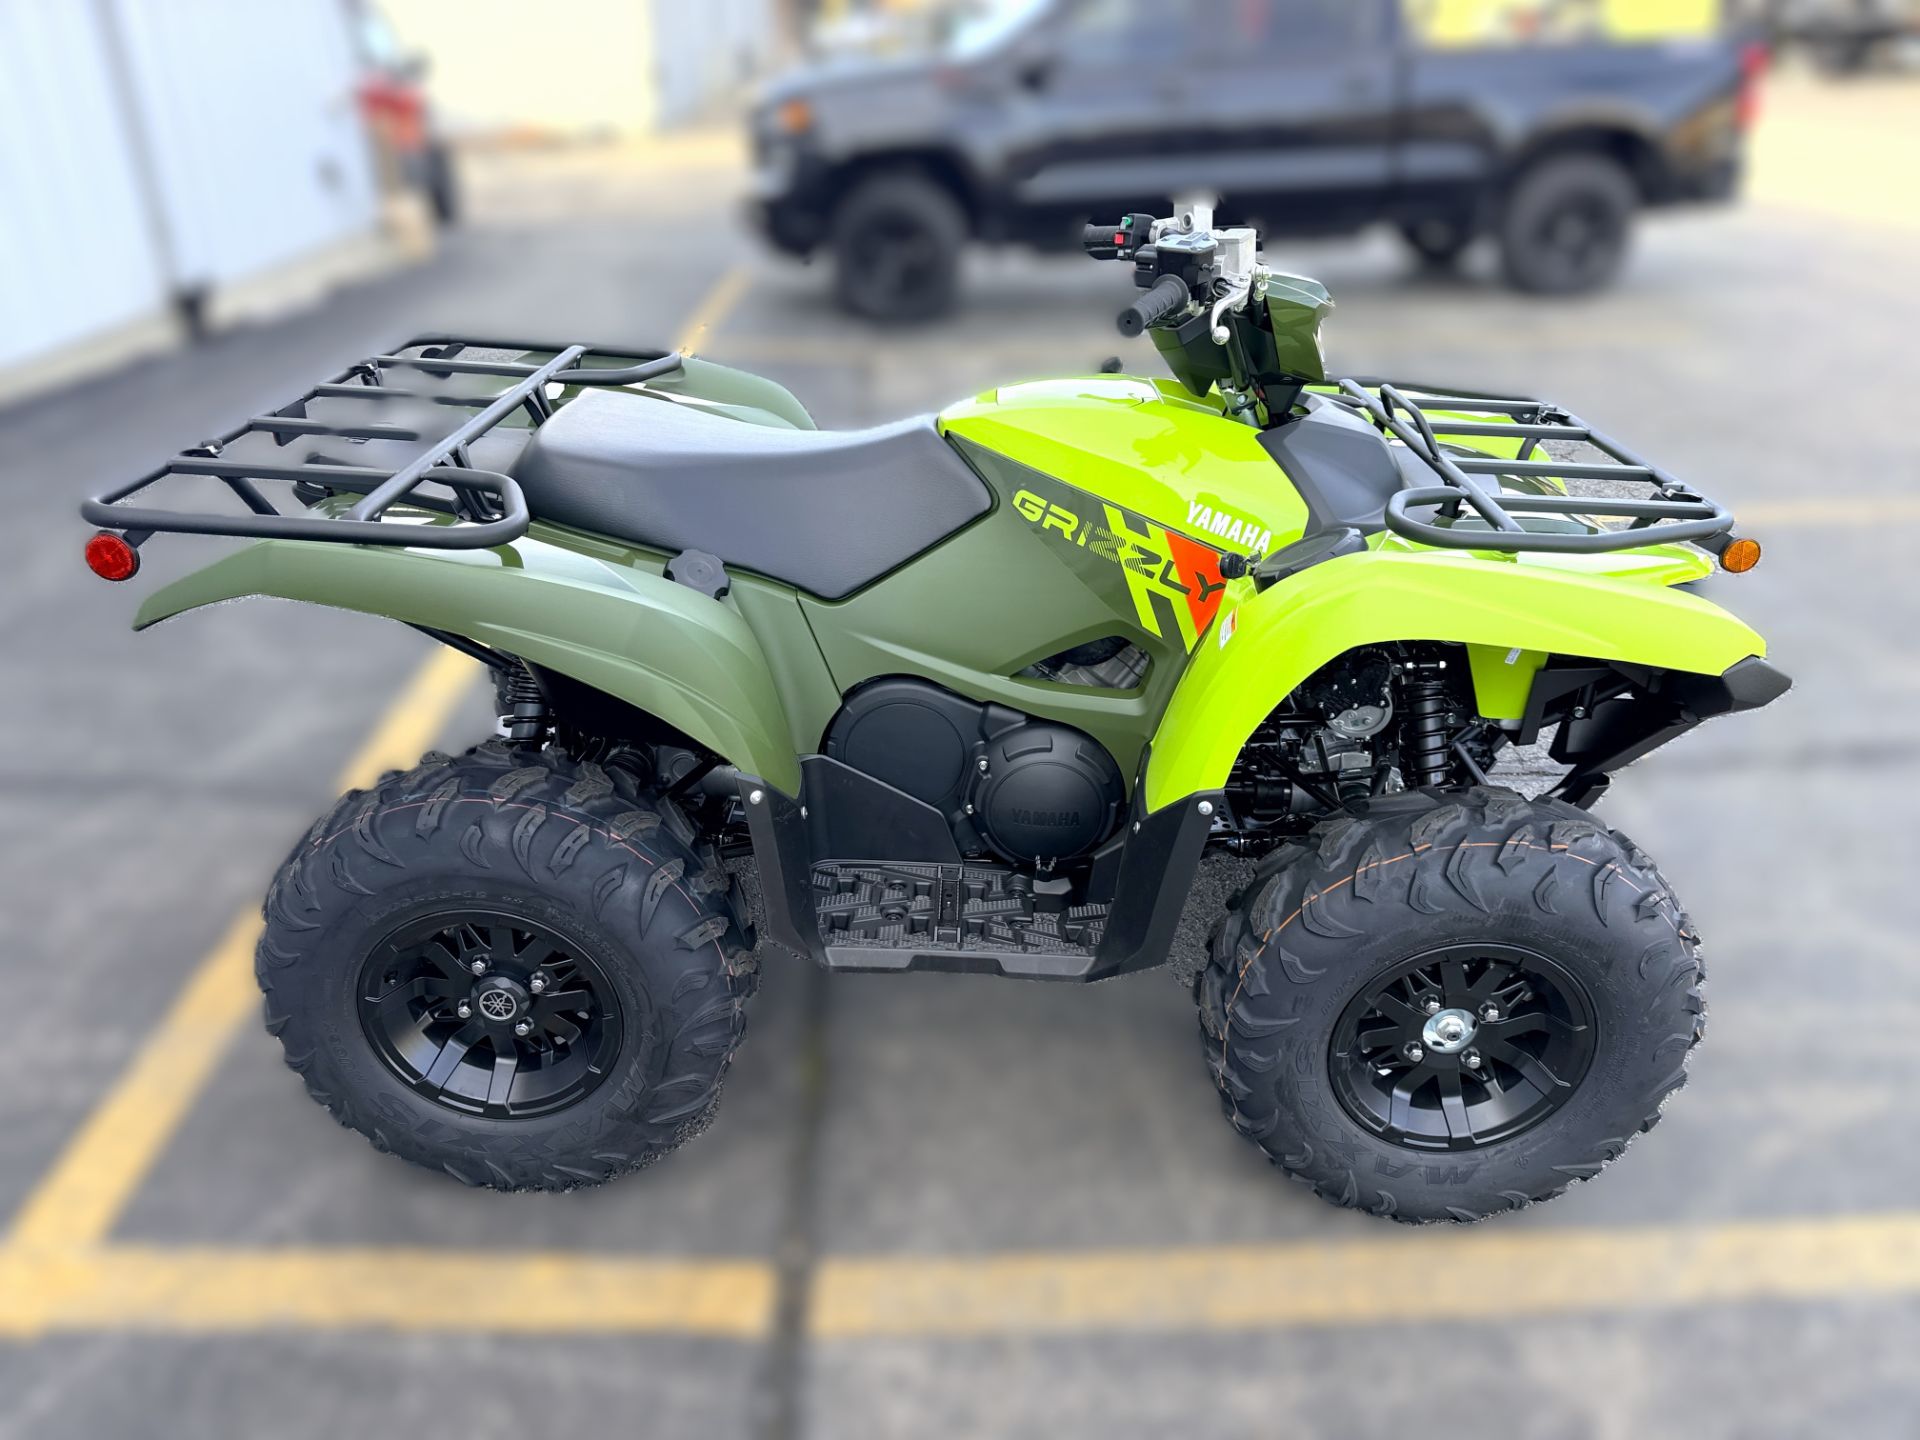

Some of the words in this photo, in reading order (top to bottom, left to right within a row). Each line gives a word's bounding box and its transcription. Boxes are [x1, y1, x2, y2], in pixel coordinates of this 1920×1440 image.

[1012, 489, 1226, 602] GRIZZLY
[1186, 500, 1273, 553] YAMAHA
[1011, 808, 1081, 828] YAMAHA
